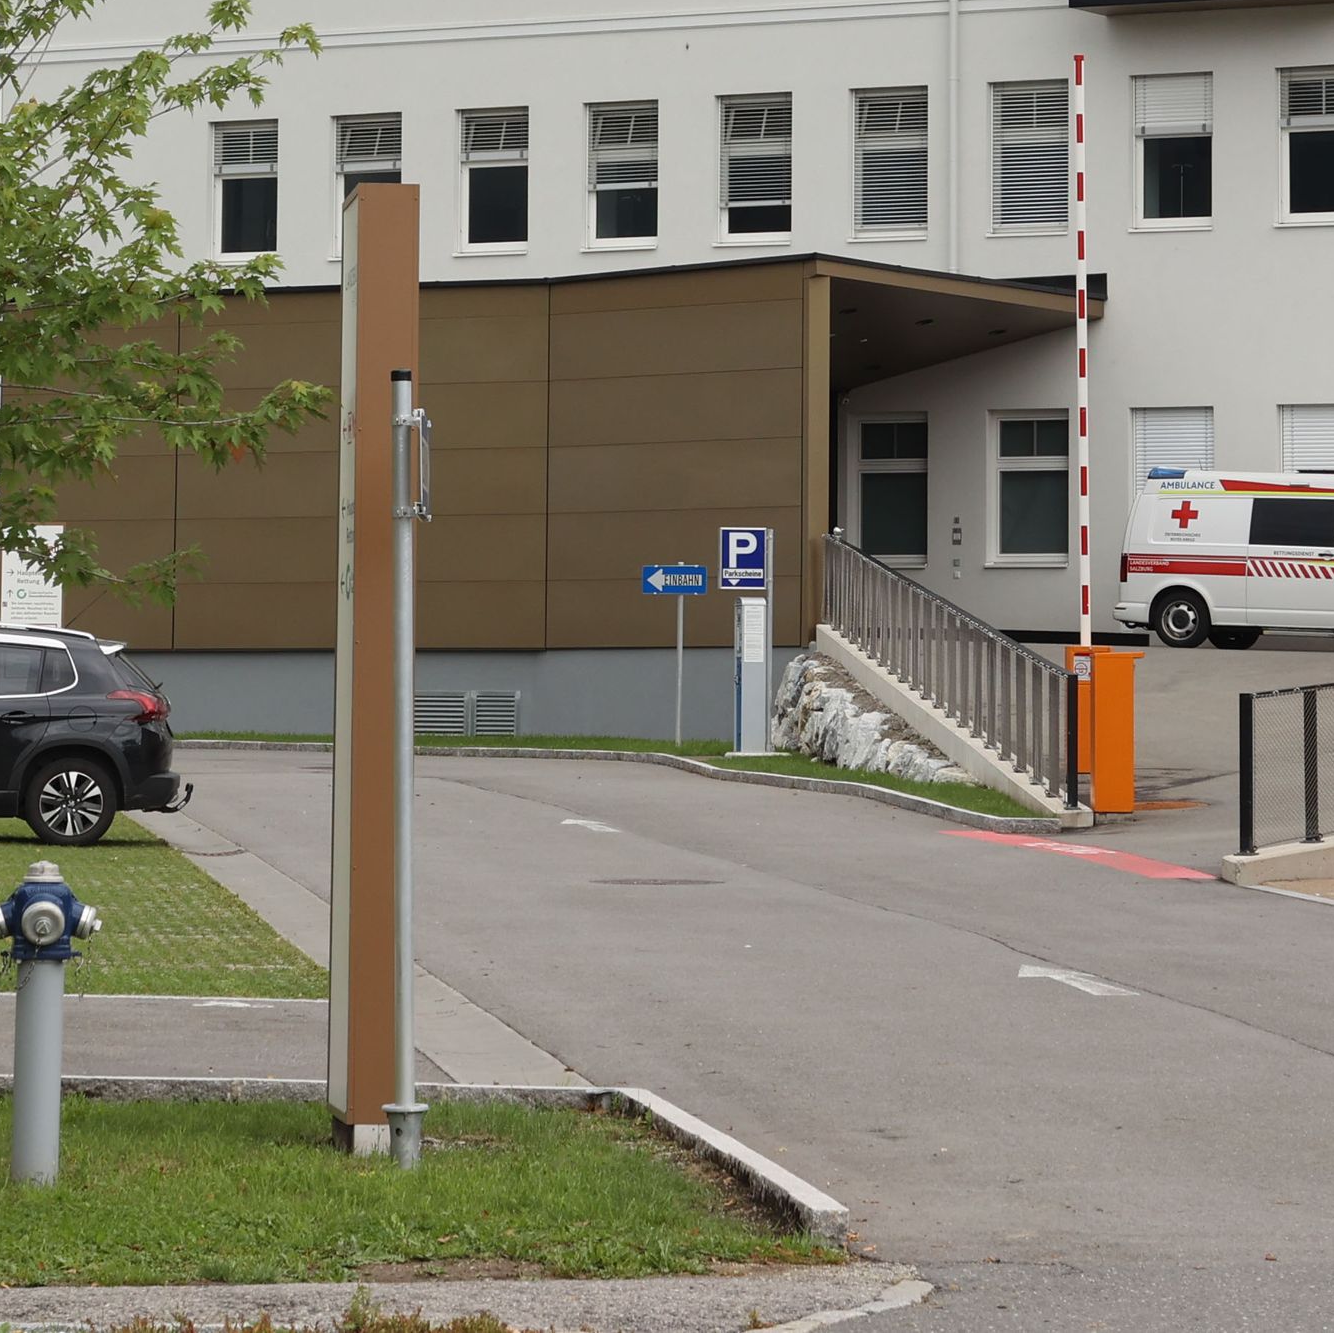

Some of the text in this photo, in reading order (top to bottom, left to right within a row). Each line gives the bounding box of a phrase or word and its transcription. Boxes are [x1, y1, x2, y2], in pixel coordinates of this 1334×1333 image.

[1160, 481, 1215, 490] AMBULANCE
[729, 532, 757, 568] P
[1129, 559, 1170, 567] LANDESVERBAND
[724, 570, 762, 578] Parkscheine
[664, 574, 700, 586] EINBAHN
